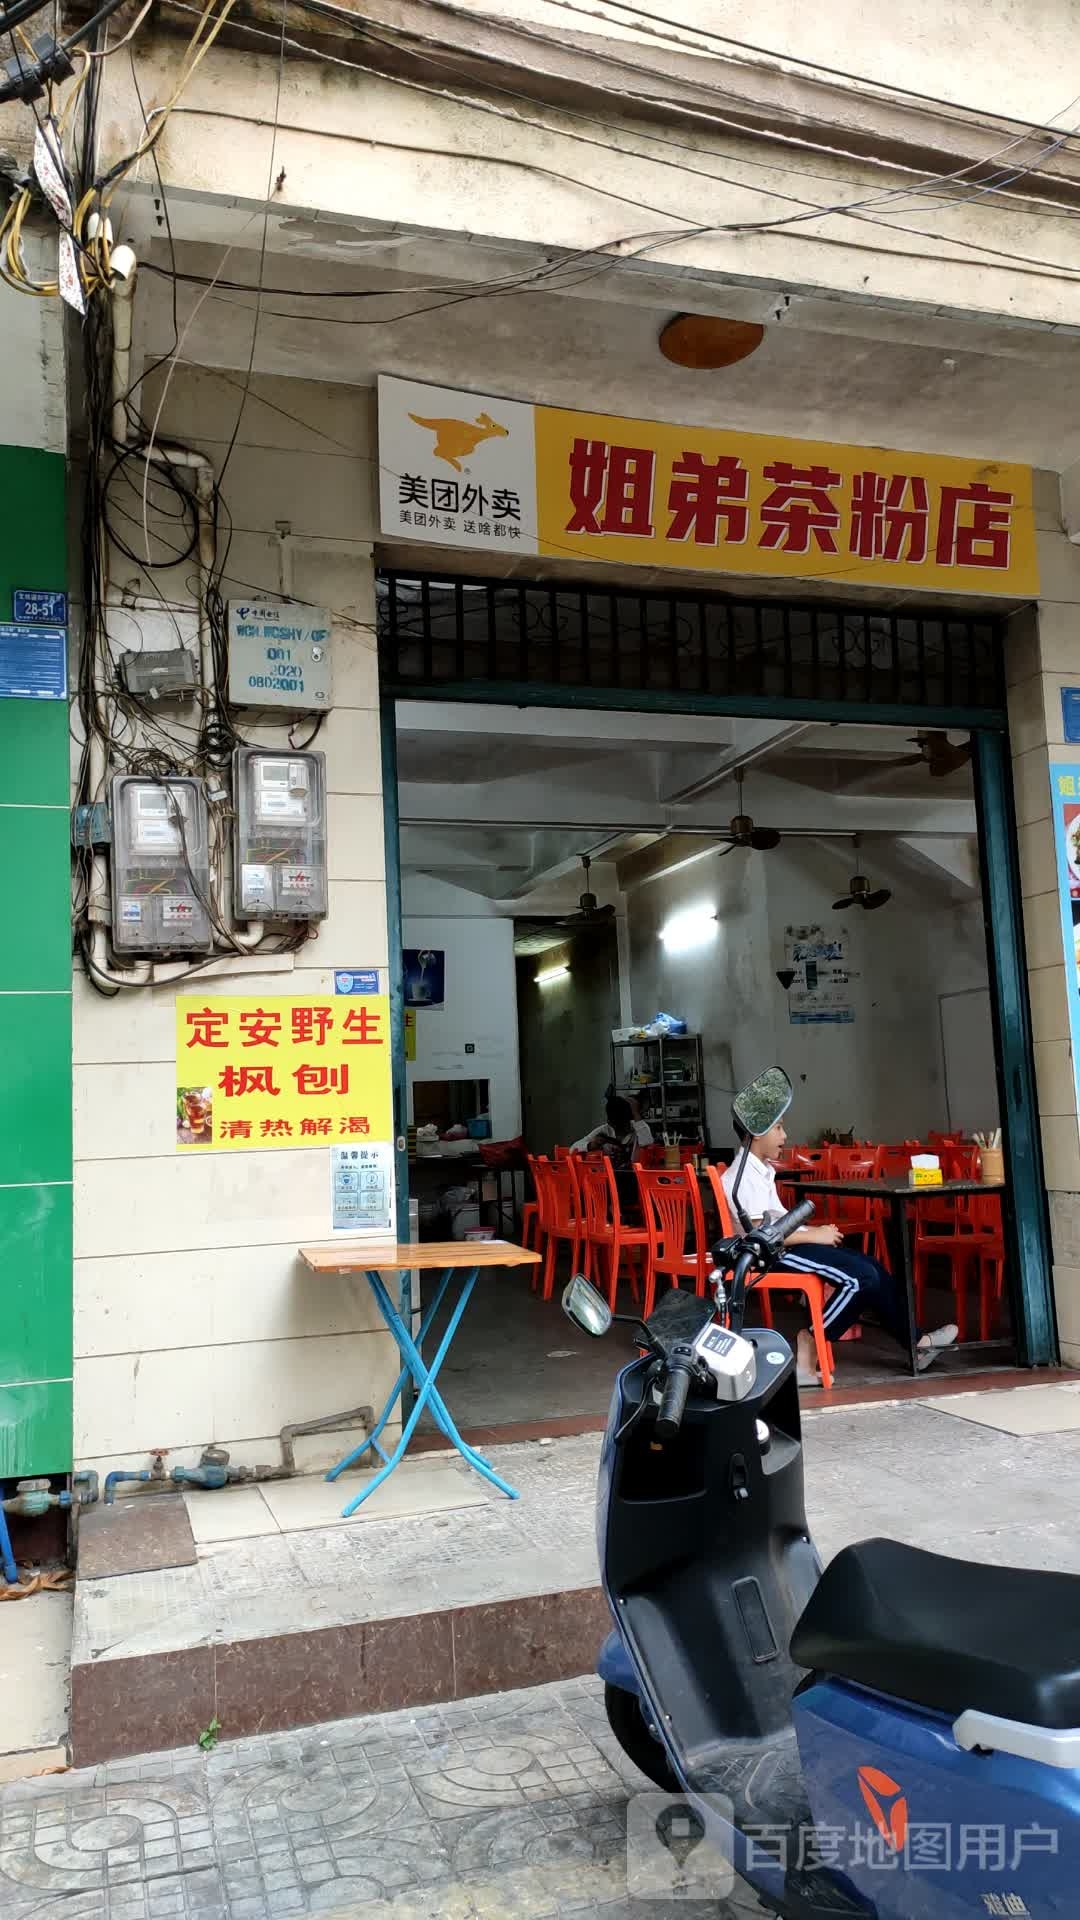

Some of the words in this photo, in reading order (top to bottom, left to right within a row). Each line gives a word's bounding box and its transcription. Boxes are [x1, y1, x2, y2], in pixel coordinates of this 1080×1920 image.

[398, 473, 521, 521] 美团外卖
[565, 438, 1014, 570] 姐弟茶粉店
[399, 509, 457, 532] 美团外卖
[463, 520, 521, 539] 送啥都快
[25, 602, 54, 616] 28-51
[186, 1006, 384, 1049] 定安野生
[218, 1063, 349, 1097] 枫刨
[219, 1116, 371, 1140] 清热解渴
